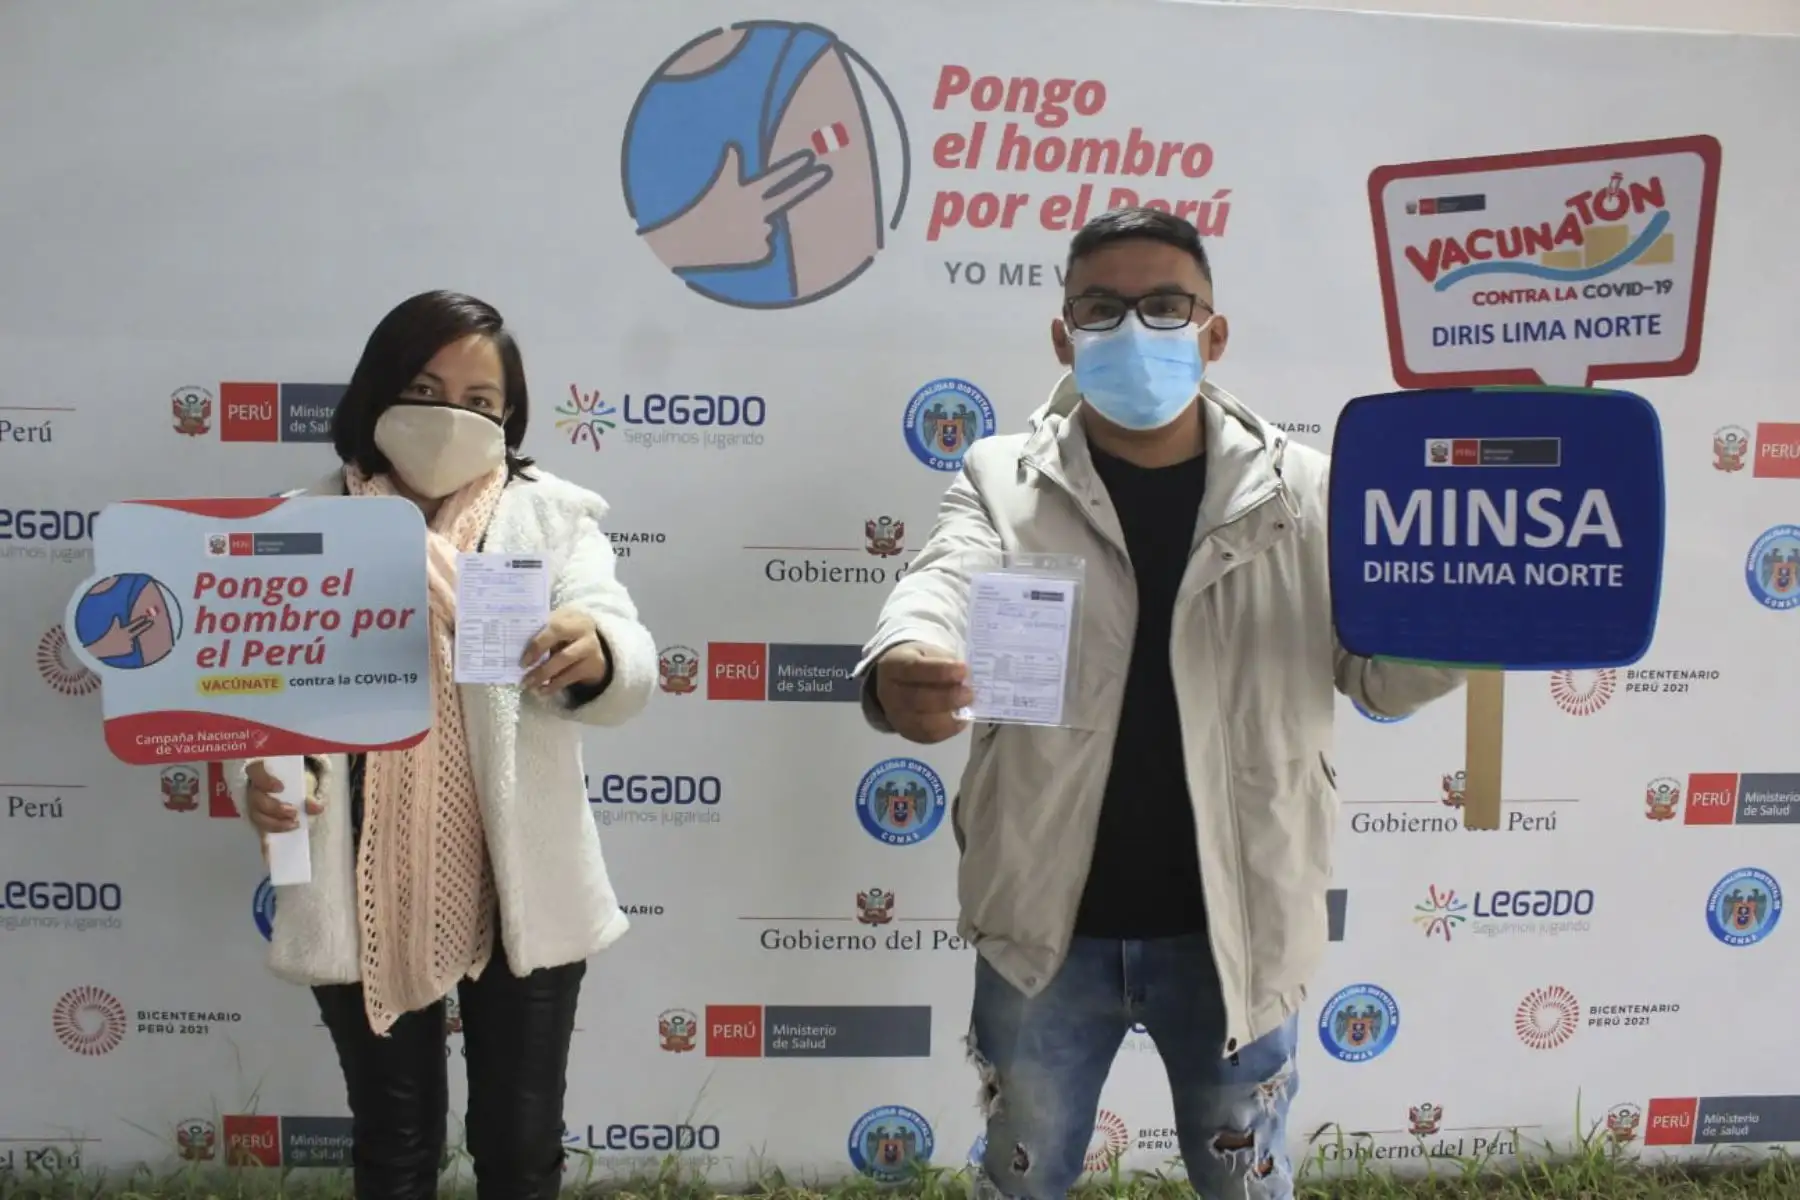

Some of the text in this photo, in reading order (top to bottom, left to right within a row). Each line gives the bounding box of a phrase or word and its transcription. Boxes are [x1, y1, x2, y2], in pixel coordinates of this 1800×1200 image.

[932, 64, 1107, 129] Pongo
[932, 121, 1213, 179] el hombro
[926, 190, 1029, 241] por
[1040, 183, 1093, 231] el
[944, 261, 987, 286] YO
[999, 264, 1043, 287] ME
[1472, 279, 1674, 306] CONTRA LA COVID-19
[1432, 313, 1662, 347] DIRIS LIMA NORTE
[228, 401, 272, 421] PERÚ
[290, 420, 306, 433] de
[624, 428, 700, 449] Seguimos
[1364, 488, 1623, 549] MINSA
[765, 558, 886, 584] Gobierno
[1364, 560, 1623, 587] DIRIS LIMA NORTE
[194, 568, 354, 606] Pongo el
[194, 603, 415, 639] hombro por
[197, 636, 326, 668] el Perú
[715, 660, 760, 680] PERÚ
[778, 664, 845, 679] Ministerio
[1626, 669, 1720, 680] BICENTENARIO
[201, 673, 418, 692] VACÚNATE contra la COVID-19
[777, 680, 833, 693] de Salud
[1662, 682, 1689, 692] 2021
[135, 729, 250, 746] Campaña Nacional
[155, 740, 247, 755] de Vacunación
[1692, 788, 1732, 806] PERÚ
[1744, 788, 1800, 803] Ministerio
[7, 795, 64, 818] Perú
[1743, 804, 1790, 816] de Salud
[1351, 810, 1557, 833] Gobierno Perú
[760, 928, 877, 951] Gobierno
[886, 929, 921, 951] del
[137, 1010, 242, 1022] BICENTENARIO
[1589, 1004, 1680, 1015] BICENTENARIO
[179, 1024, 209, 1034] 2021
[713, 1021, 757, 1038] PERÚ
[1624, 1016, 1650, 1026] 2021
[773, 1024, 837, 1037] Ministerio
[773, 1037, 826, 1049] de Salud
[1653, 1111, 1690, 1128] PERÚ
[1704, 1112, 1760, 1124] Ministerio
[231, 1130, 273, 1149] PERÚ
[1702, 1125, 1749, 1136] de Salud
[290, 1134, 354, 1147] Ministerio
[1430, 1137, 1463, 1158] del
[291, 1148, 306, 1160] de
